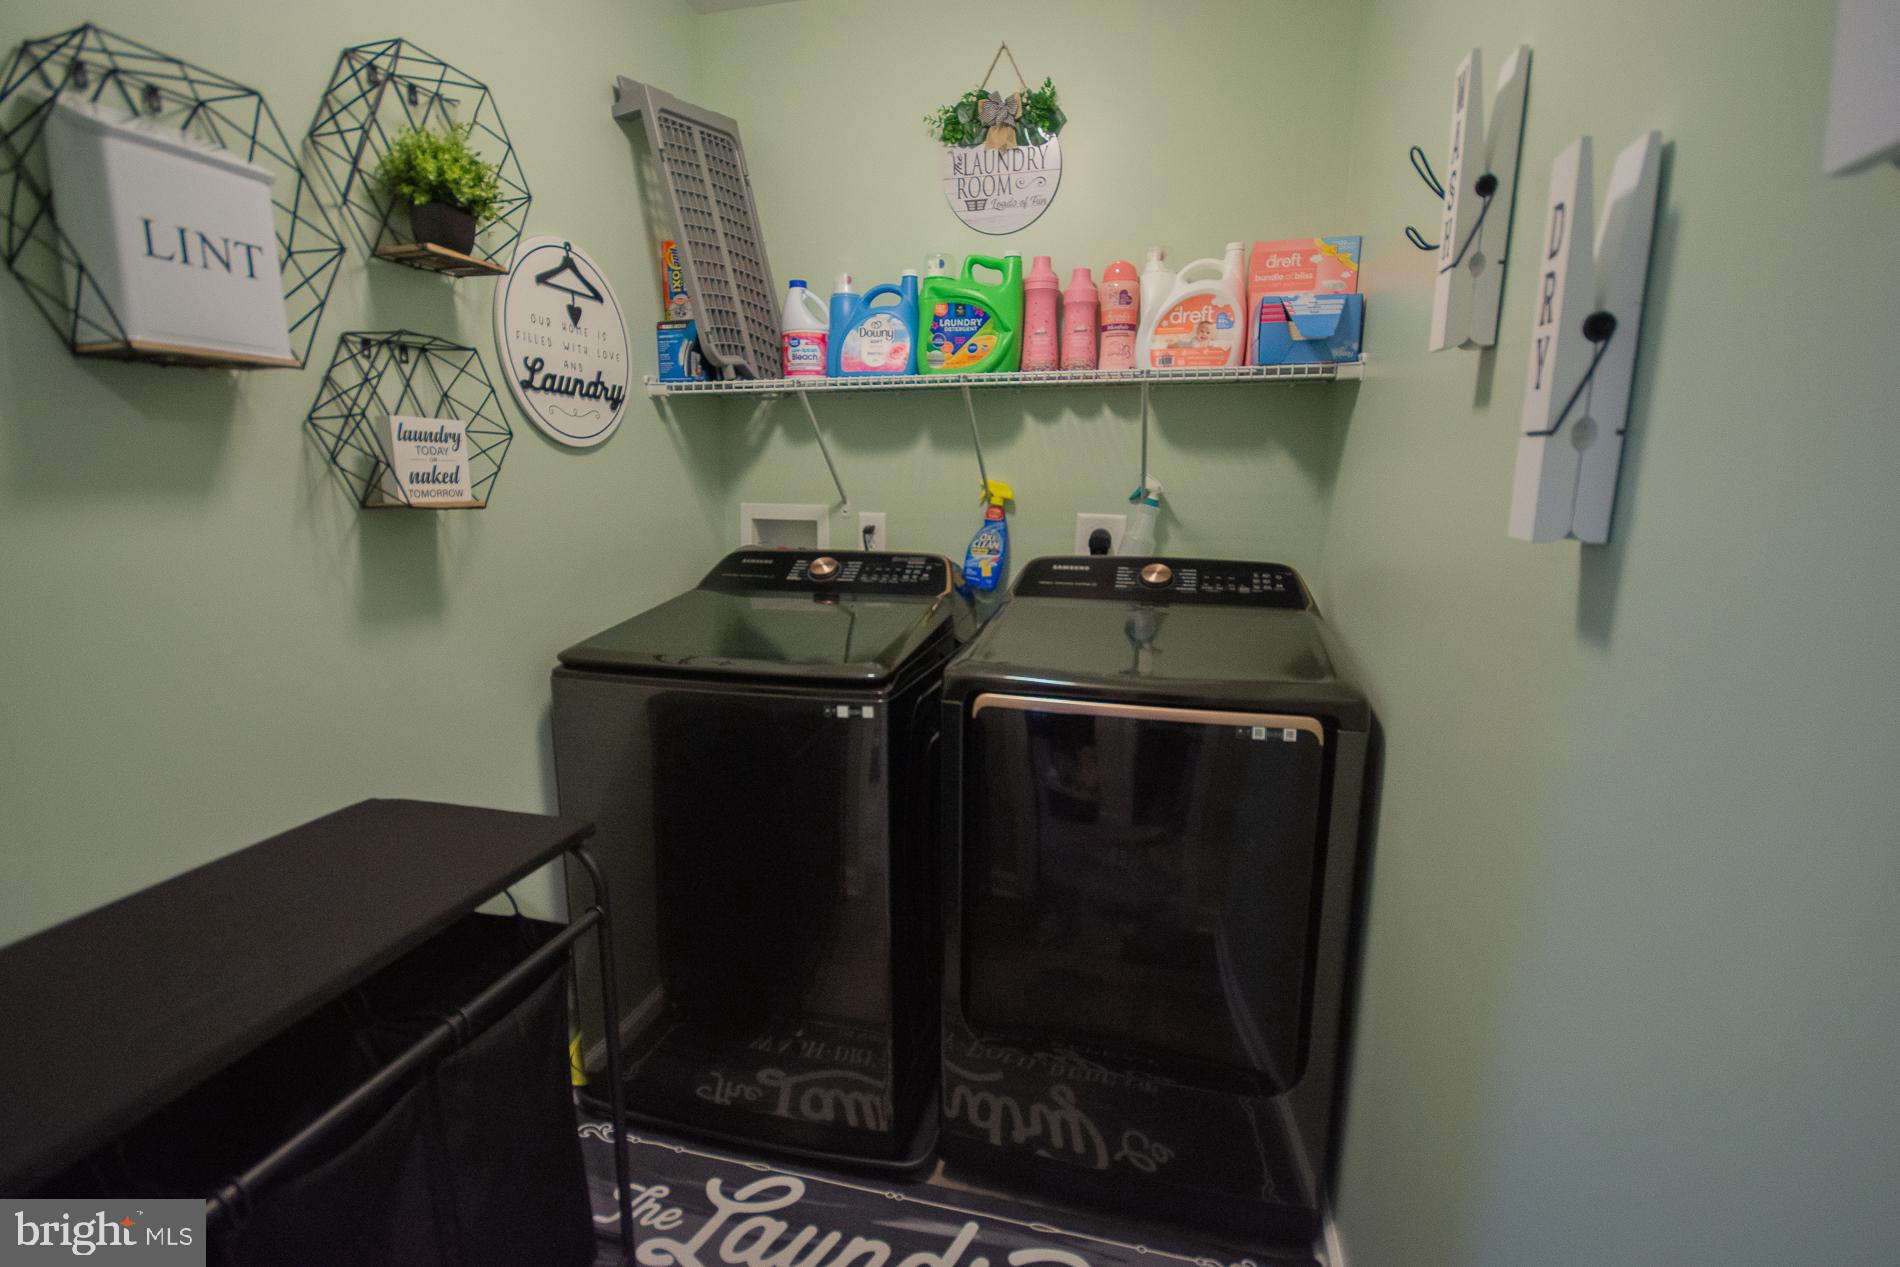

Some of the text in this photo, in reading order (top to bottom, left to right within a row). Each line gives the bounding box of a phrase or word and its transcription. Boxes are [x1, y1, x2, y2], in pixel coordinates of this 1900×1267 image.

[964, 145, 1048, 176] LAUNDRY
[957, 175, 1012, 199] ROOM
[140, 216, 264, 280] LINT
[1265, 252, 1302, 269] dreft
[1255, 271, 1283, 282] bundle
[1294, 271, 1313, 280] bliss
[1536, 202, 1565, 391] DRY
[939, 318, 982, 326] LAUNDRY
[1170, 304, 1215, 324] dreft
[530, 313, 607, 342] OUR HOME IS
[859, 328, 894, 341] Downy
[516, 330, 621, 363] FILLED WITH LOVE
[791, 352, 818, 361] Bleach
[563, 360, 583, 373] AND
[520, 356, 626, 412] Laundry
[397, 421, 461, 452] laundry
[415, 445, 449, 456] TODAY
[408, 464, 460, 485] naked
[408, 488, 464, 499] TOMORROW
